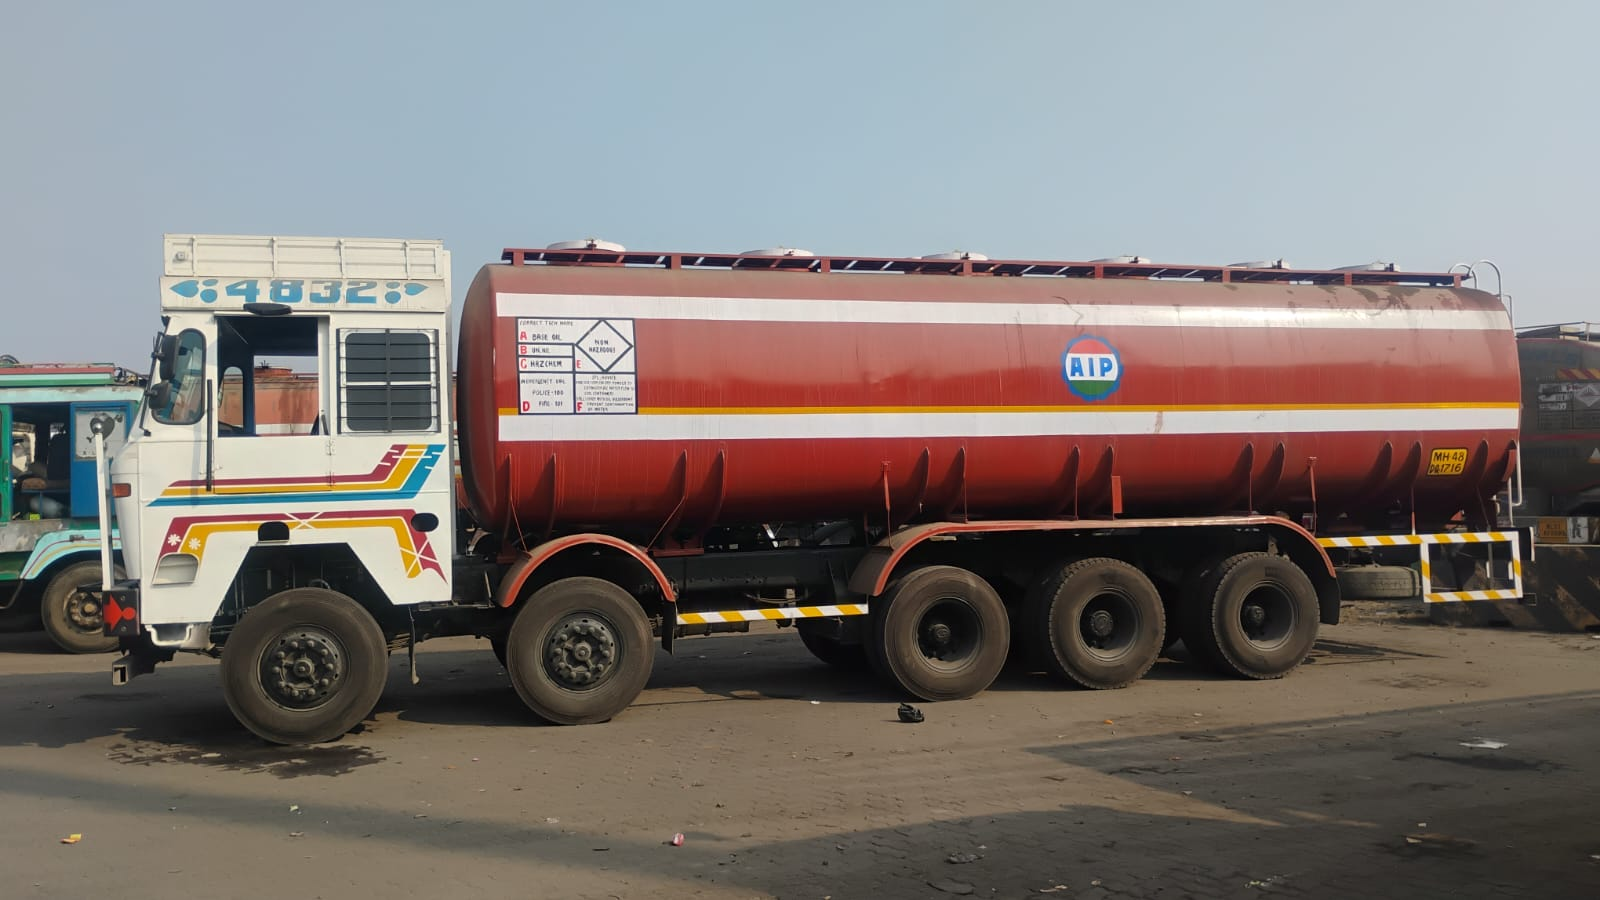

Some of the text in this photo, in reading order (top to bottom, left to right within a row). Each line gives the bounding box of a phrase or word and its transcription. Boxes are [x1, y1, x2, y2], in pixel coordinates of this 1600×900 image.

[225, 279, 377, 304] 4832
[520, 331, 527, 341] A
[532, 333, 548, 341] BASE
[520, 345, 527, 355] B
[520, 358, 527, 369] C
[576, 359, 582, 368] E
[1070, 357, 1113, 377] AIP
[522, 400, 531, 412] D
[576, 401, 583, 412] F
